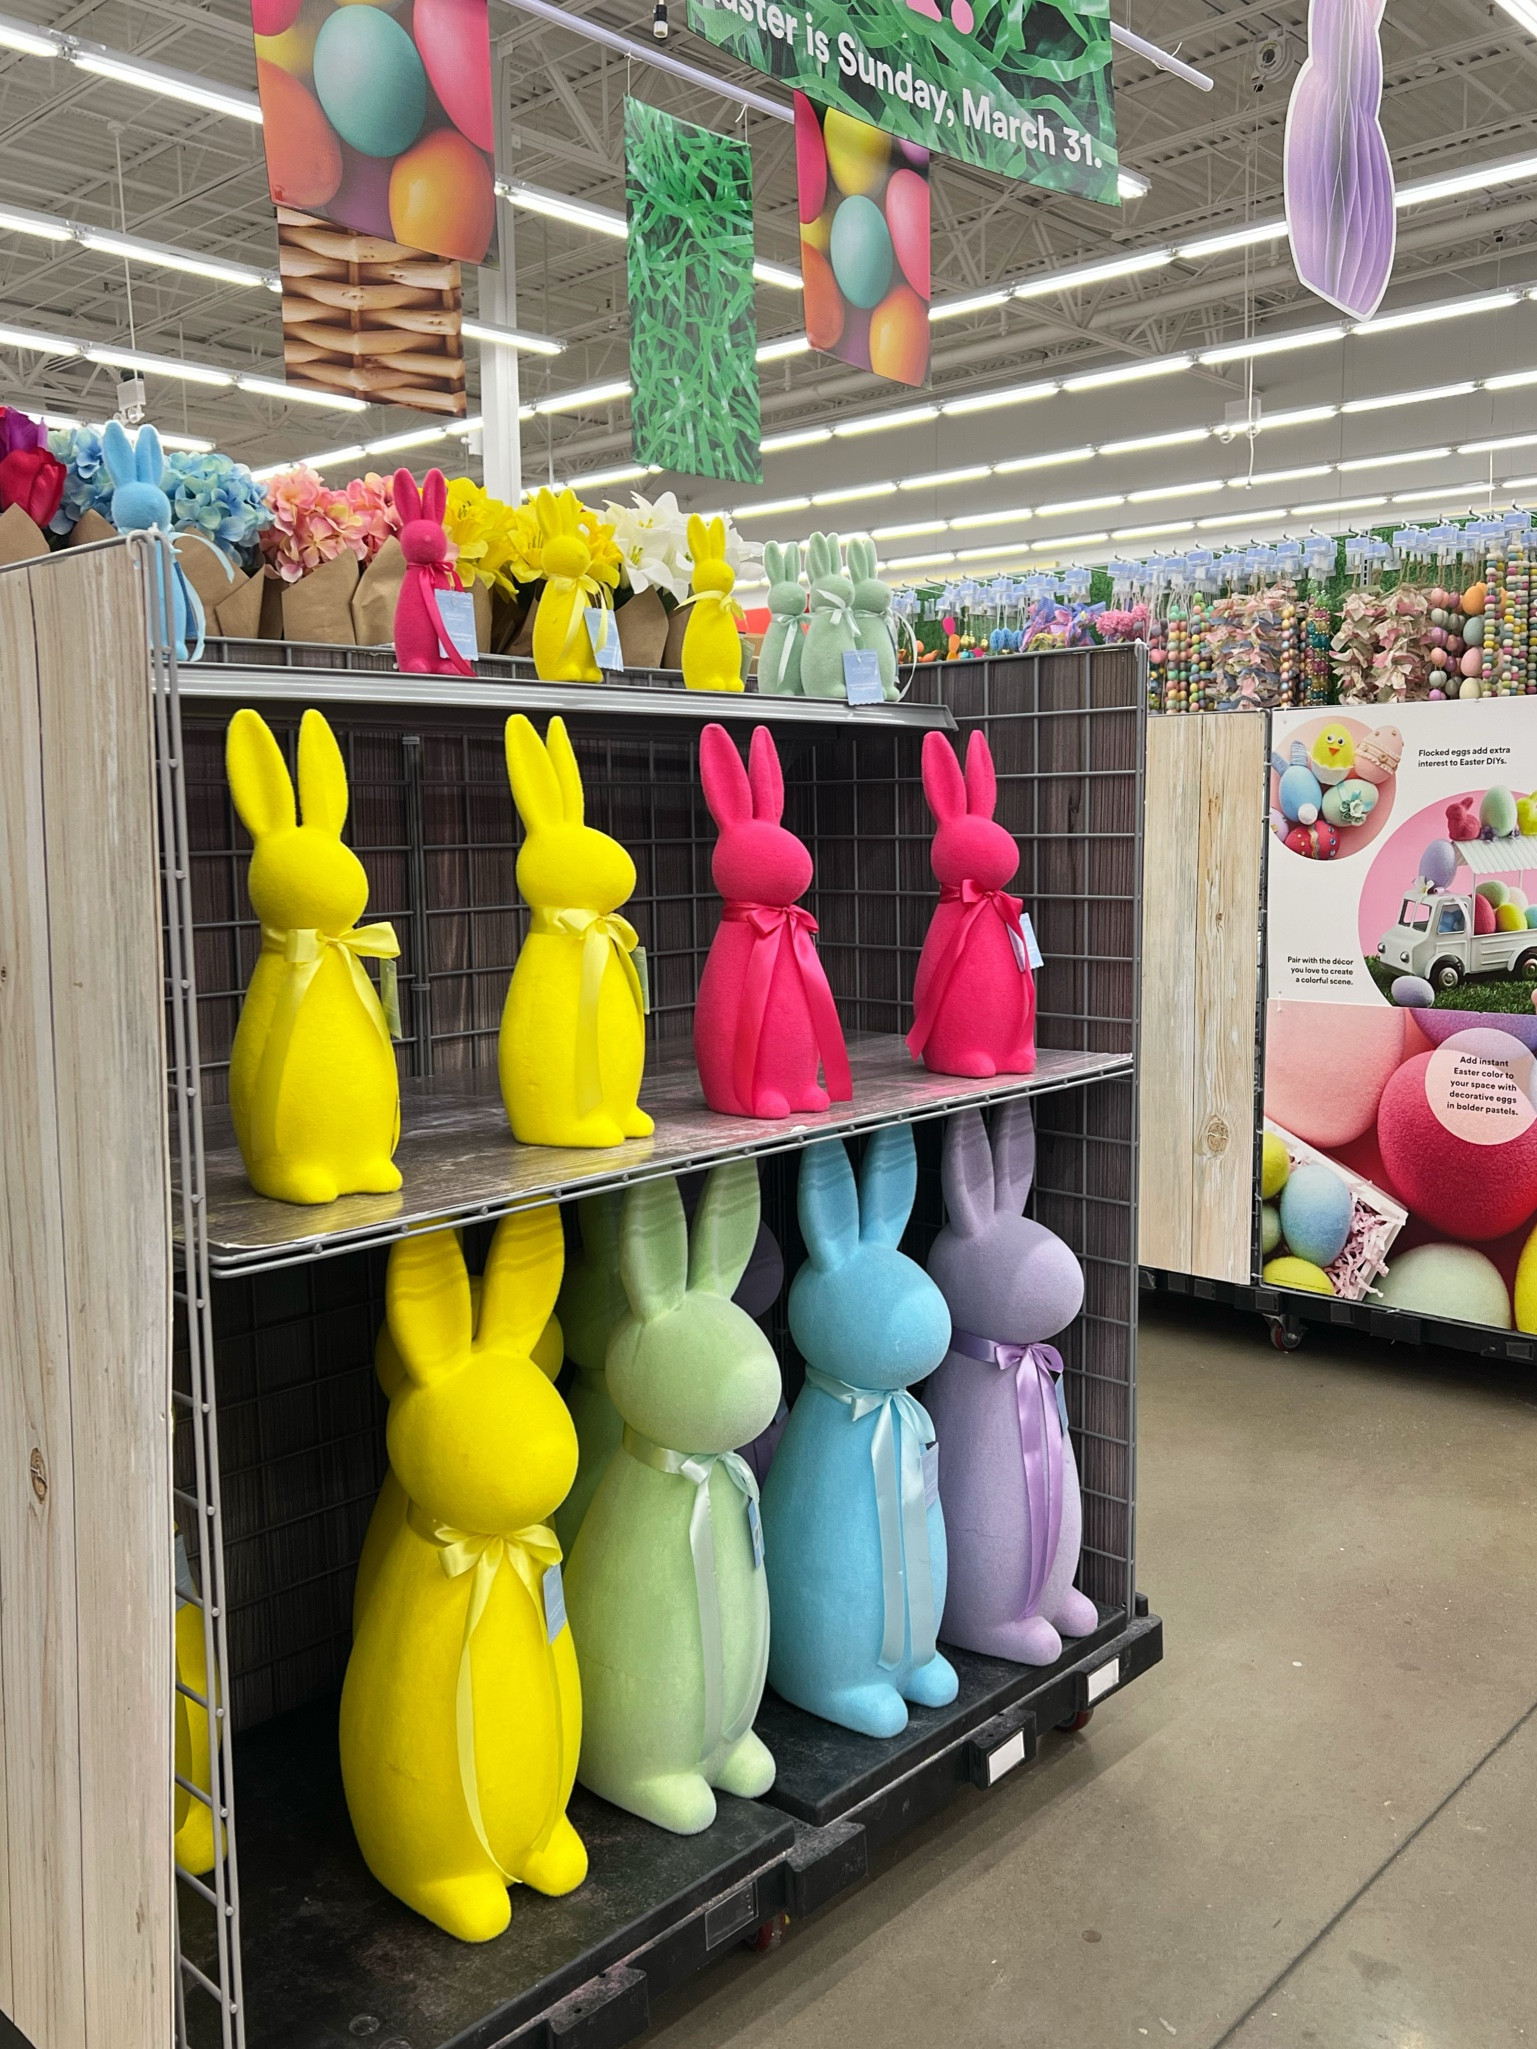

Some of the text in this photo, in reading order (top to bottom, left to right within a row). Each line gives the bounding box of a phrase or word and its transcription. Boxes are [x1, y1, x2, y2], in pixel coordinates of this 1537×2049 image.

[716, 0, 1103, 169] ster is Sunday, March 31.
[1418, 749, 1450, 757] Flocked
[1451, 749, 1471, 757] eggs
[1472, 747, 1488, 755] add
[1459, 758, 1485, 766] Easter
[1486, 757, 1507, 765] DIYs.
[1460, 1056, 1509, 1067] Add instant
[1454, 1067, 1480, 1076] Easter
[1471, 1082, 1496, 1090] space
[1497, 1084, 1517, 1092] with
[1449, 1091, 1517, 1105] decorative eggs
[1456, 1103, 1484, 1112] bolder
[1485, 1106, 1519, 1116] pastels.
